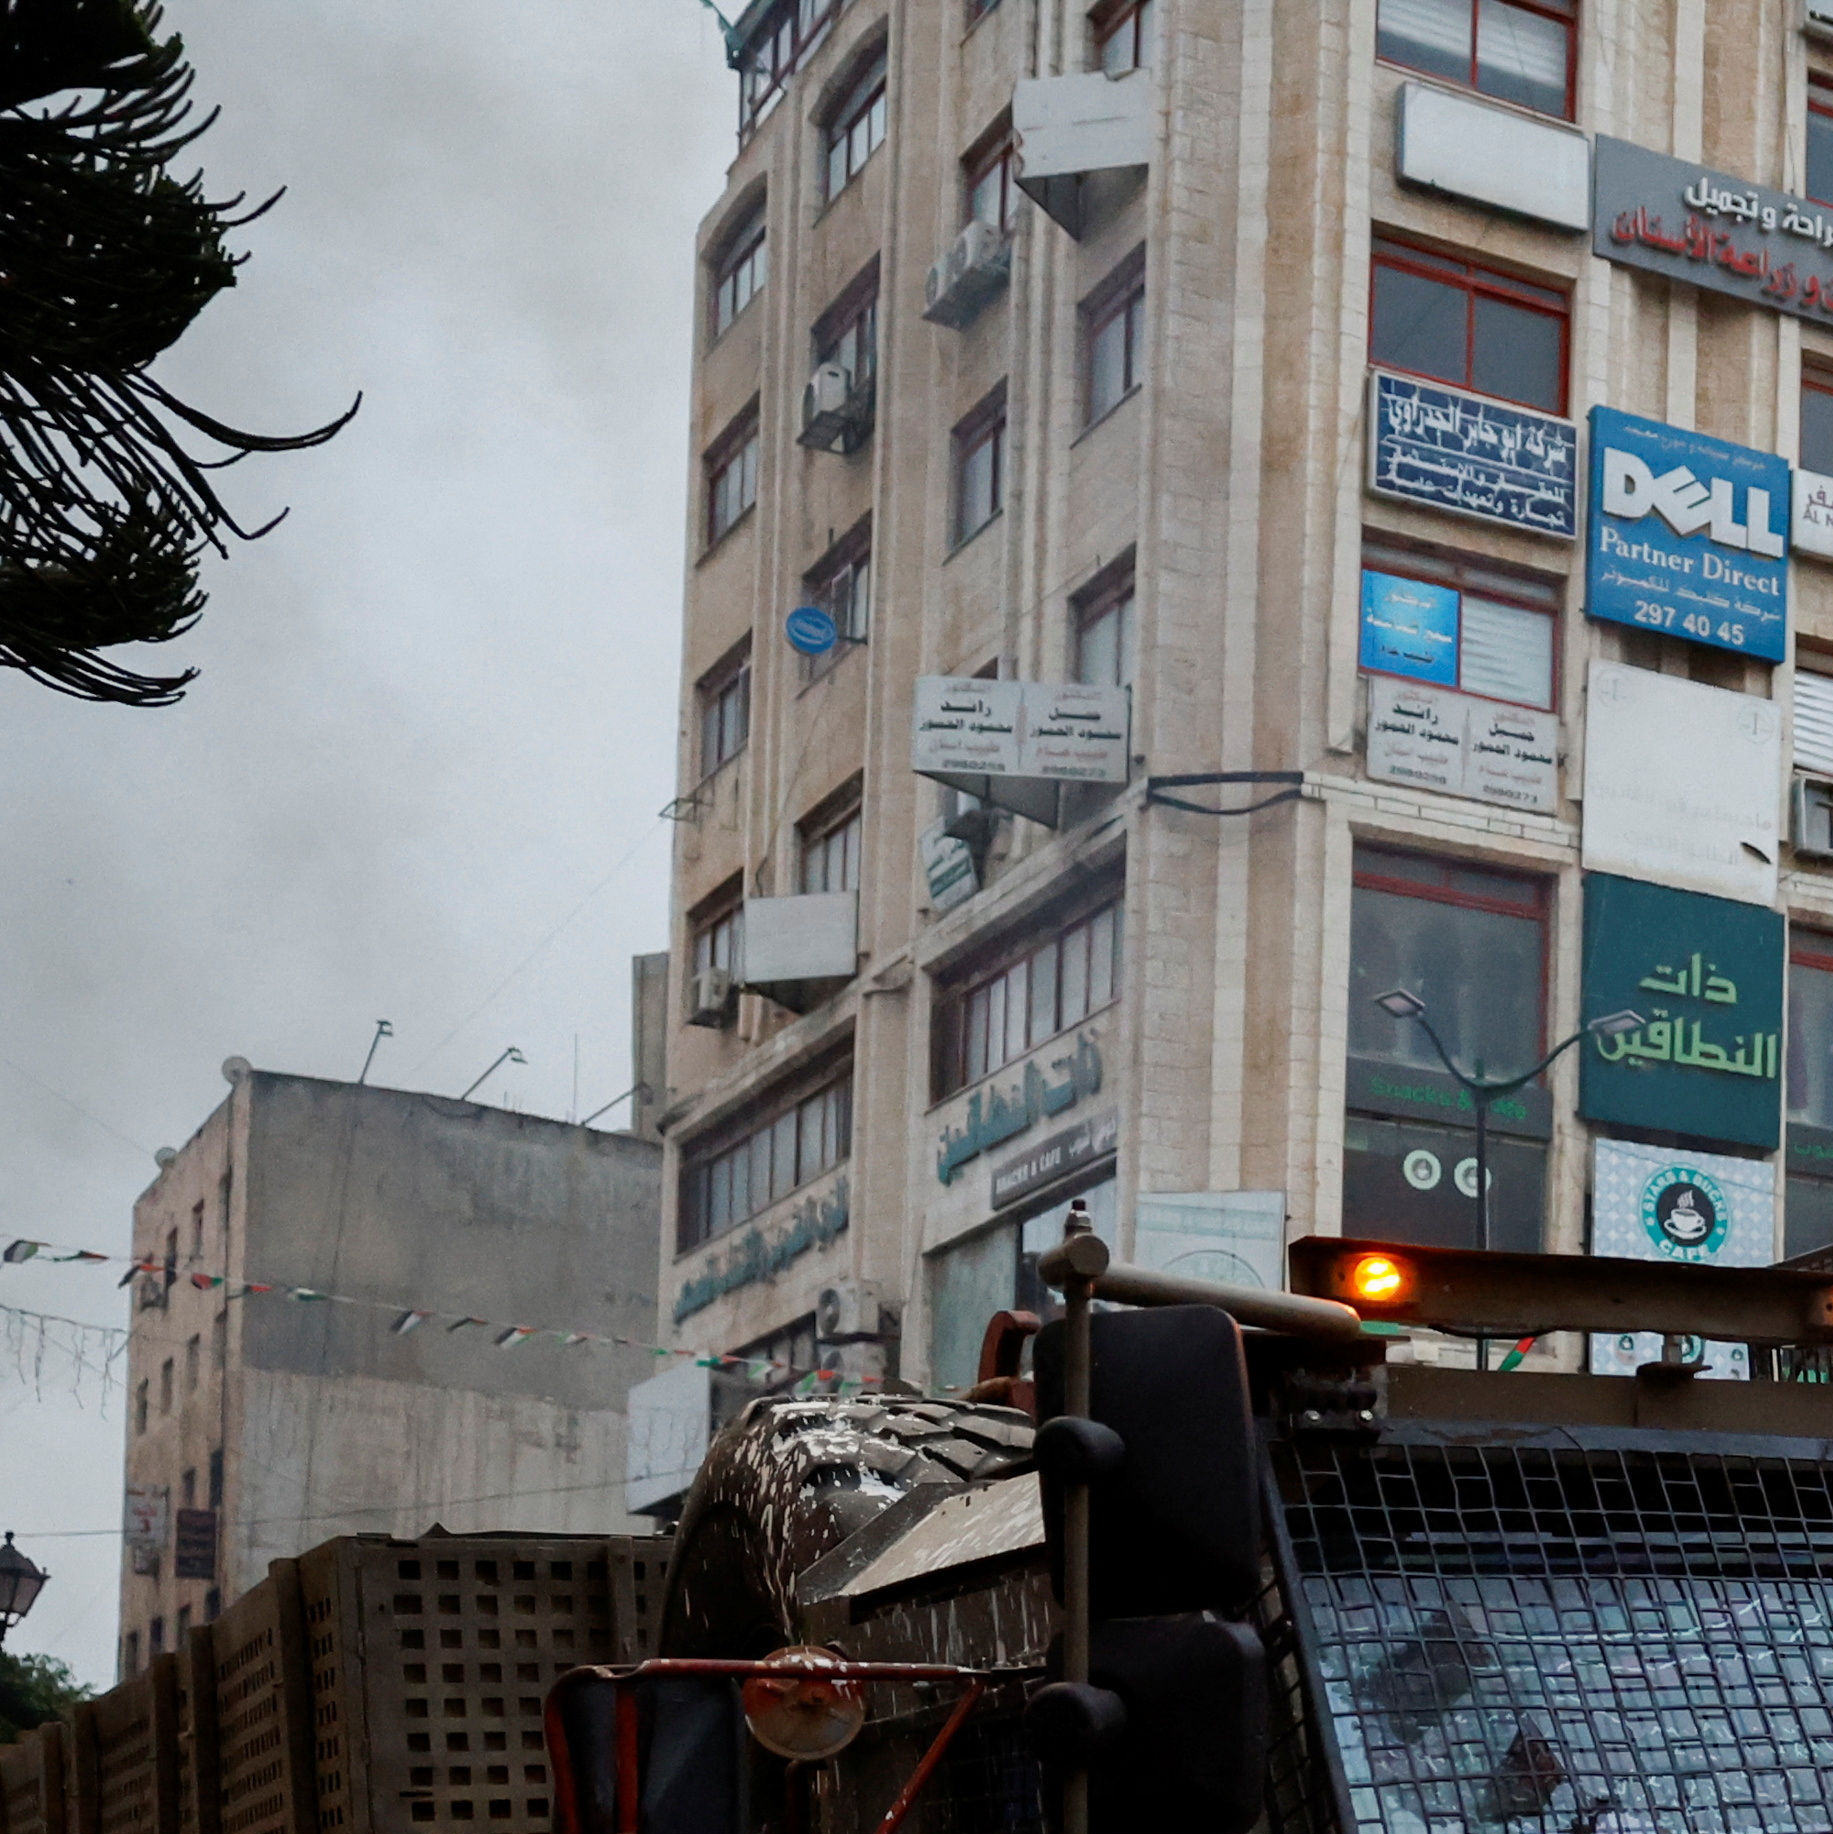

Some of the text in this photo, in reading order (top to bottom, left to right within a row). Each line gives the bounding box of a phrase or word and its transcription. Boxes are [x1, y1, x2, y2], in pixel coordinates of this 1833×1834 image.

[1602, 446, 1785, 561] DELL
[1600, 524, 1781, 597] Partner Direct
[1634, 600, 1746, 647] 297 40 45
[1638, 952, 1738, 1005] ذات
[1596, 1007, 1778, 1080] النطاقين
